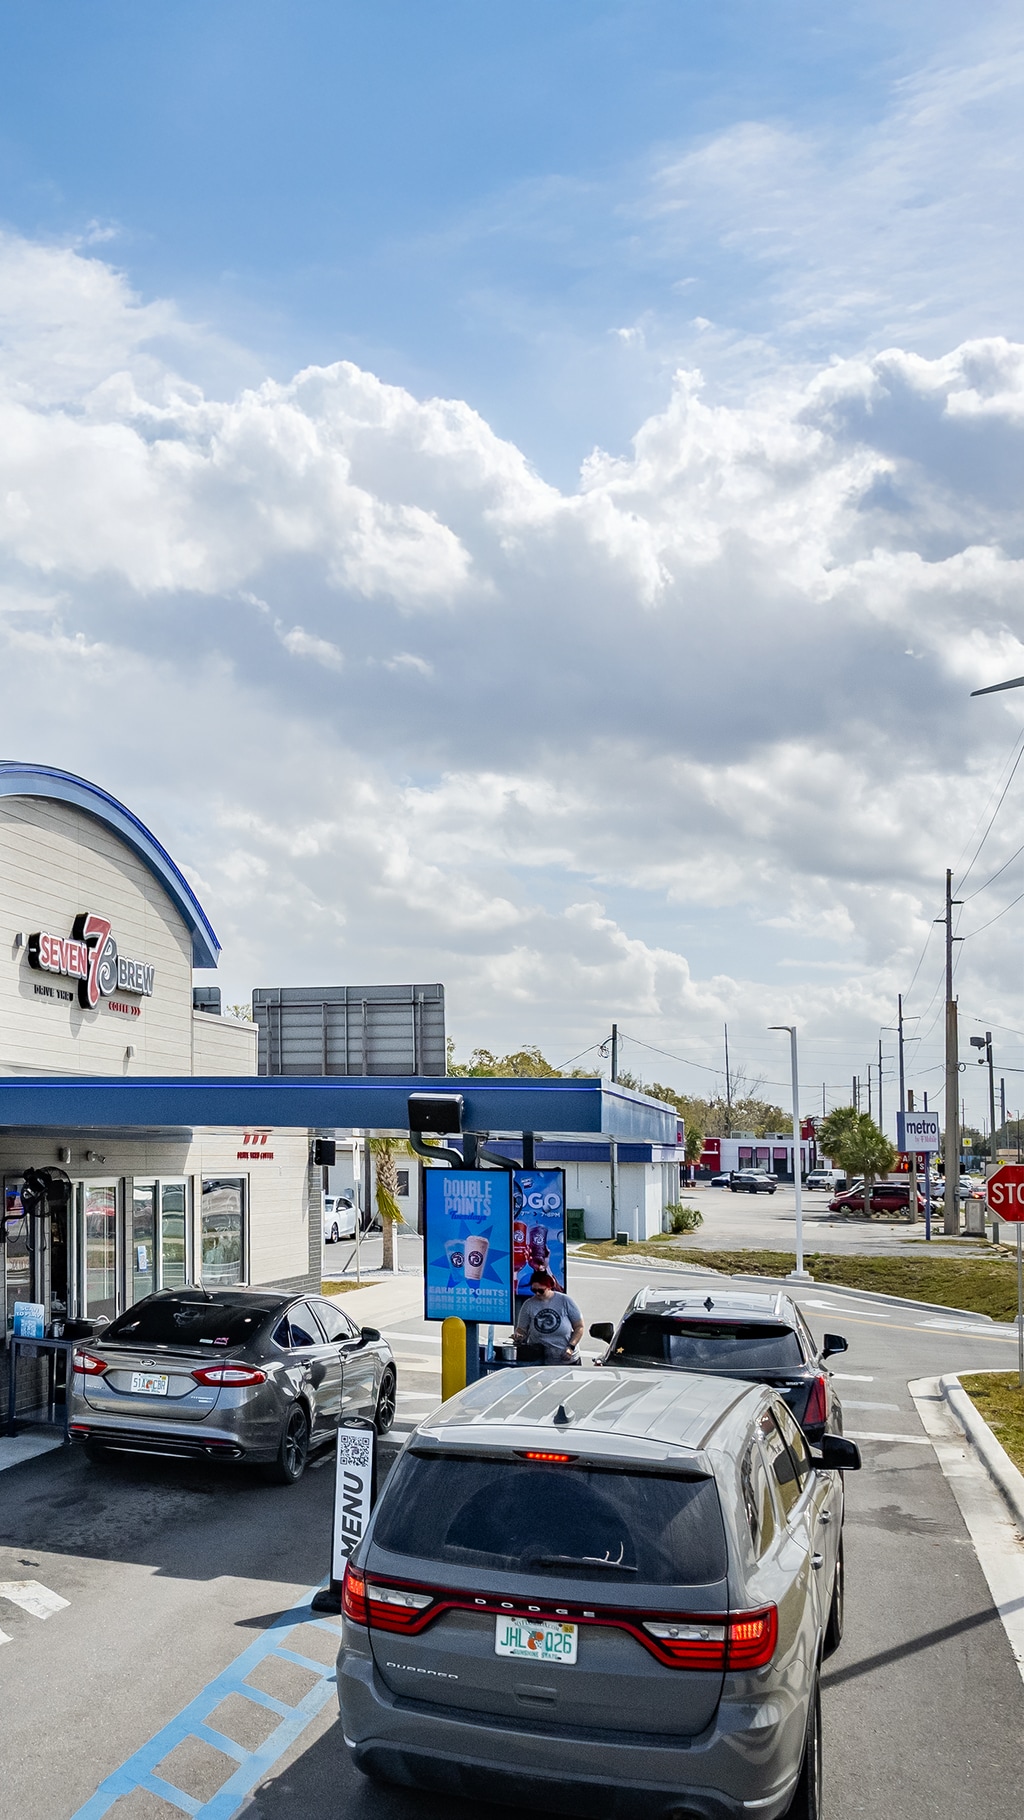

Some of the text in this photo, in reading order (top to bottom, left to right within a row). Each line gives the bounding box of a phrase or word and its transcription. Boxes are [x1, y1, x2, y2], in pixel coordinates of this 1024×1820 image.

[40, 933, 88, 979] SEVEN
[118, 957, 155, 996] BREW
[906, 1119, 936, 1134] metro
[443, 1179, 492, 1198] DOUBLE
[444, 1197, 492, 1216] POINTS
[429, 1286, 508, 1297] EARN 2X POINTS!
[429, 1294, 508, 1306] EARN 2X POINTS!
[340, 1470, 364, 1559] MENU
[474, 1598, 595, 1618] DODGE
[500, 1626, 527, 1648] JHL
